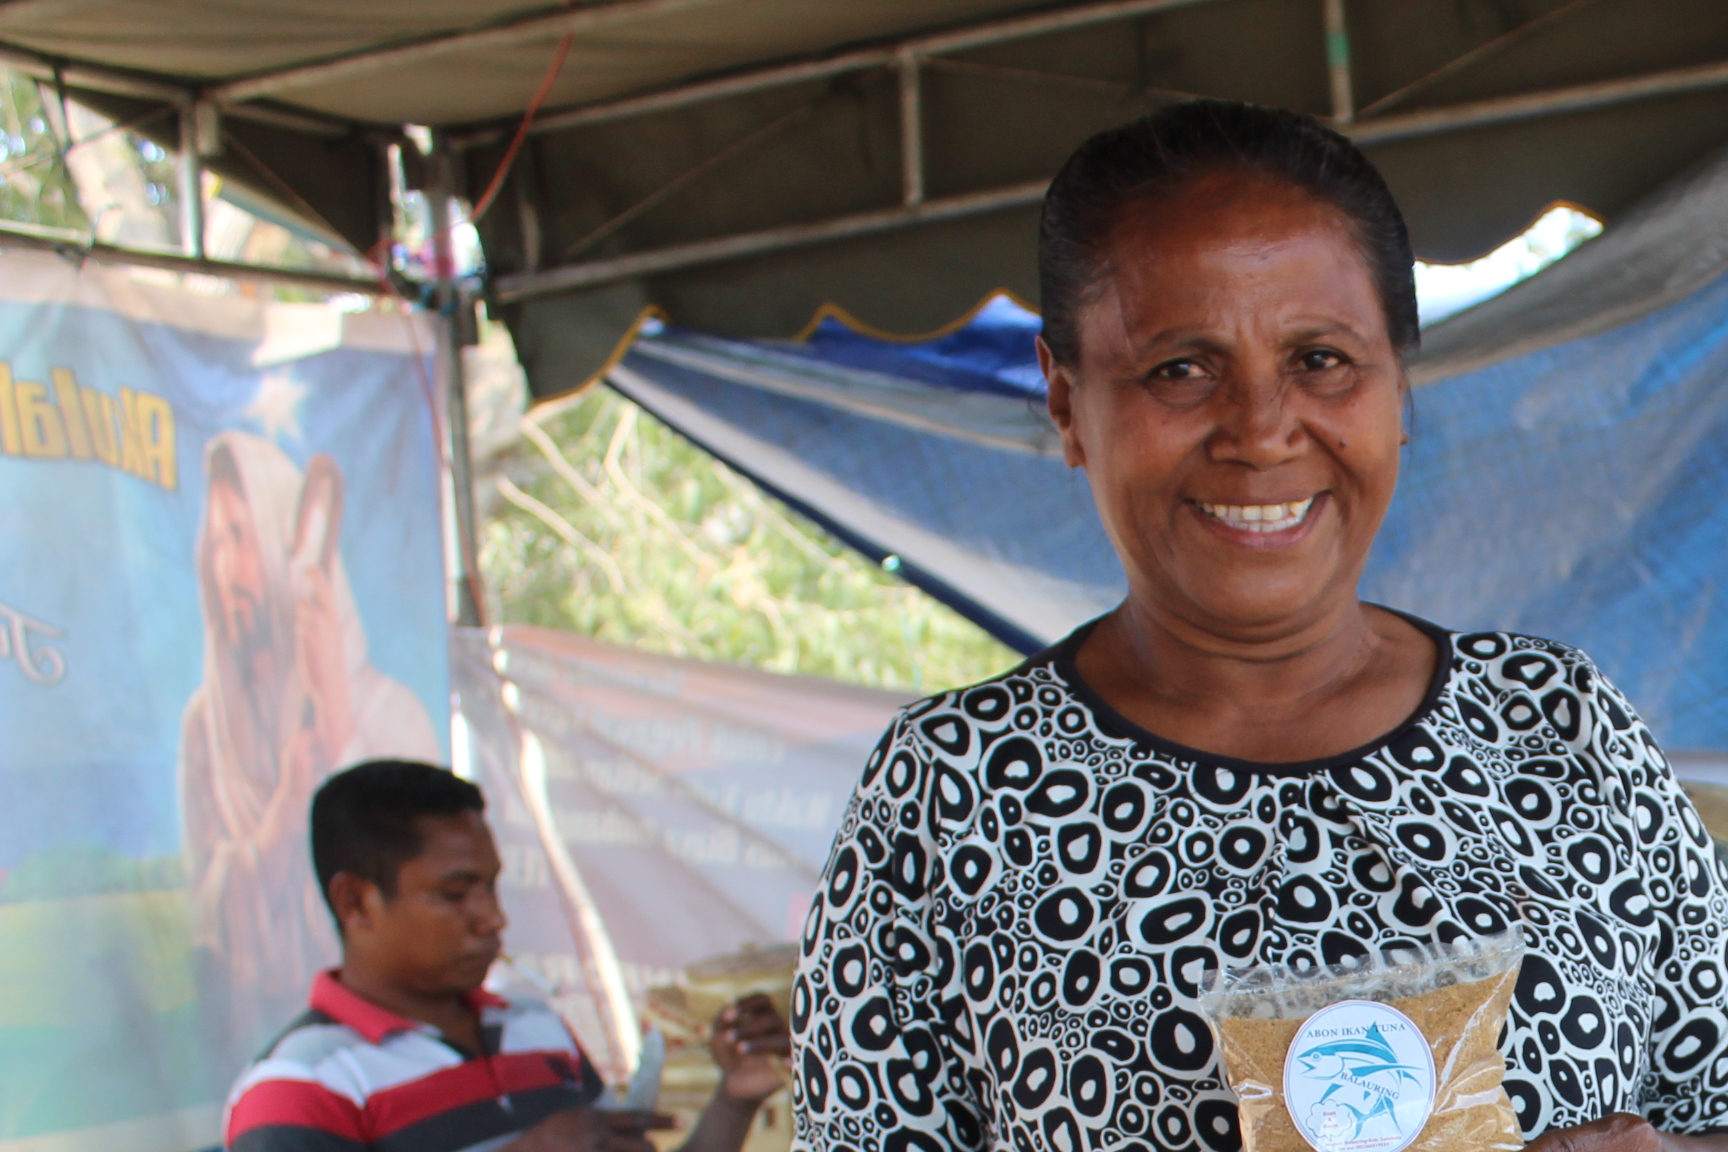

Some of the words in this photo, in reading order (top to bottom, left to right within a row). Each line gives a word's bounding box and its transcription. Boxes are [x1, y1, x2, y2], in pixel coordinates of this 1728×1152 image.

[1306, 1028, 1338, 1038] ABON
[1342, 1026, 1369, 1036] IKAN
[1340, 1072, 1399, 1100] BALAURING
